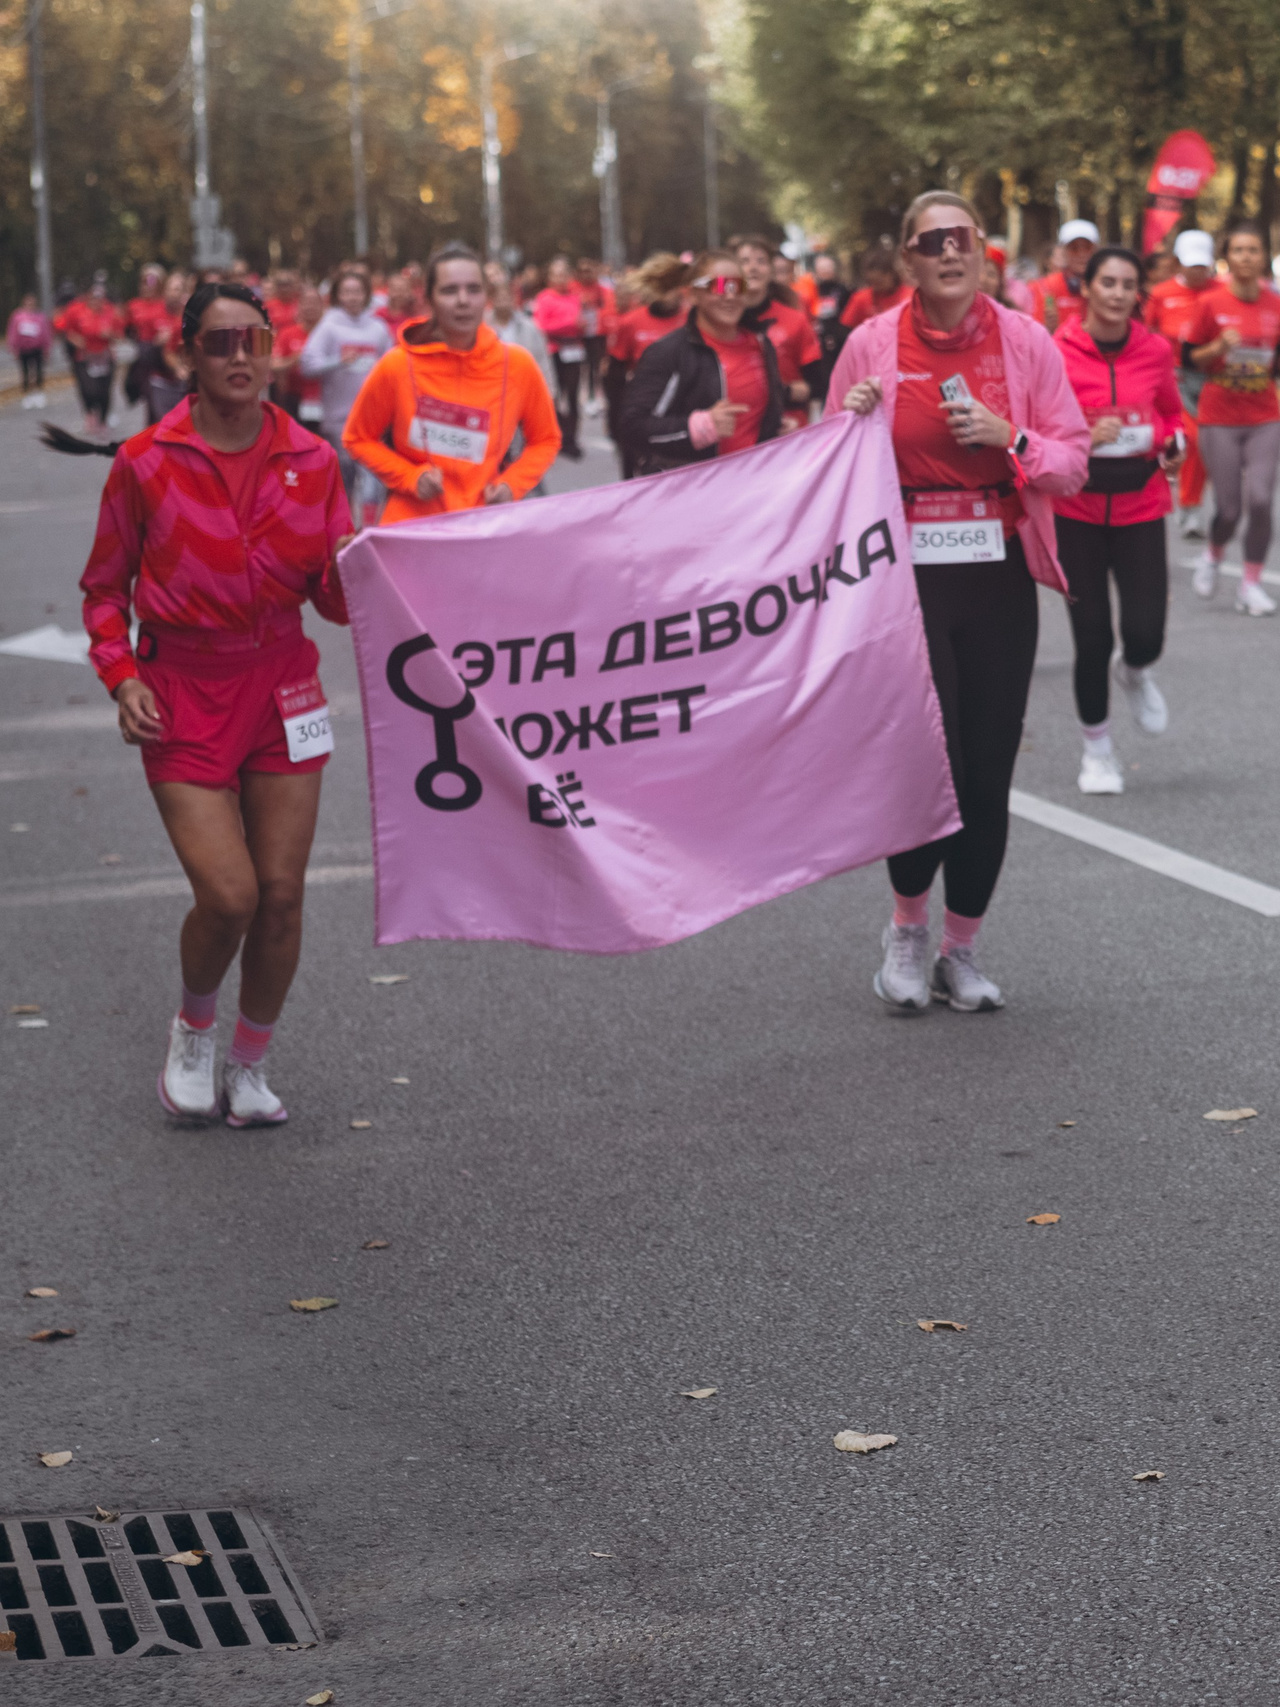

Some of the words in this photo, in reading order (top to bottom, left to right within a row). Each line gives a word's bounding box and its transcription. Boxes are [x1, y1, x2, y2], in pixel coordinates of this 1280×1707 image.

[914, 530, 987, 548] 30568
[452, 631, 576, 689] ЭТА
[598, 518, 897, 673] ДЕВОЧКА
[295, 716, 330, 744] 302
[526, 770, 597, 828] ВЁ
